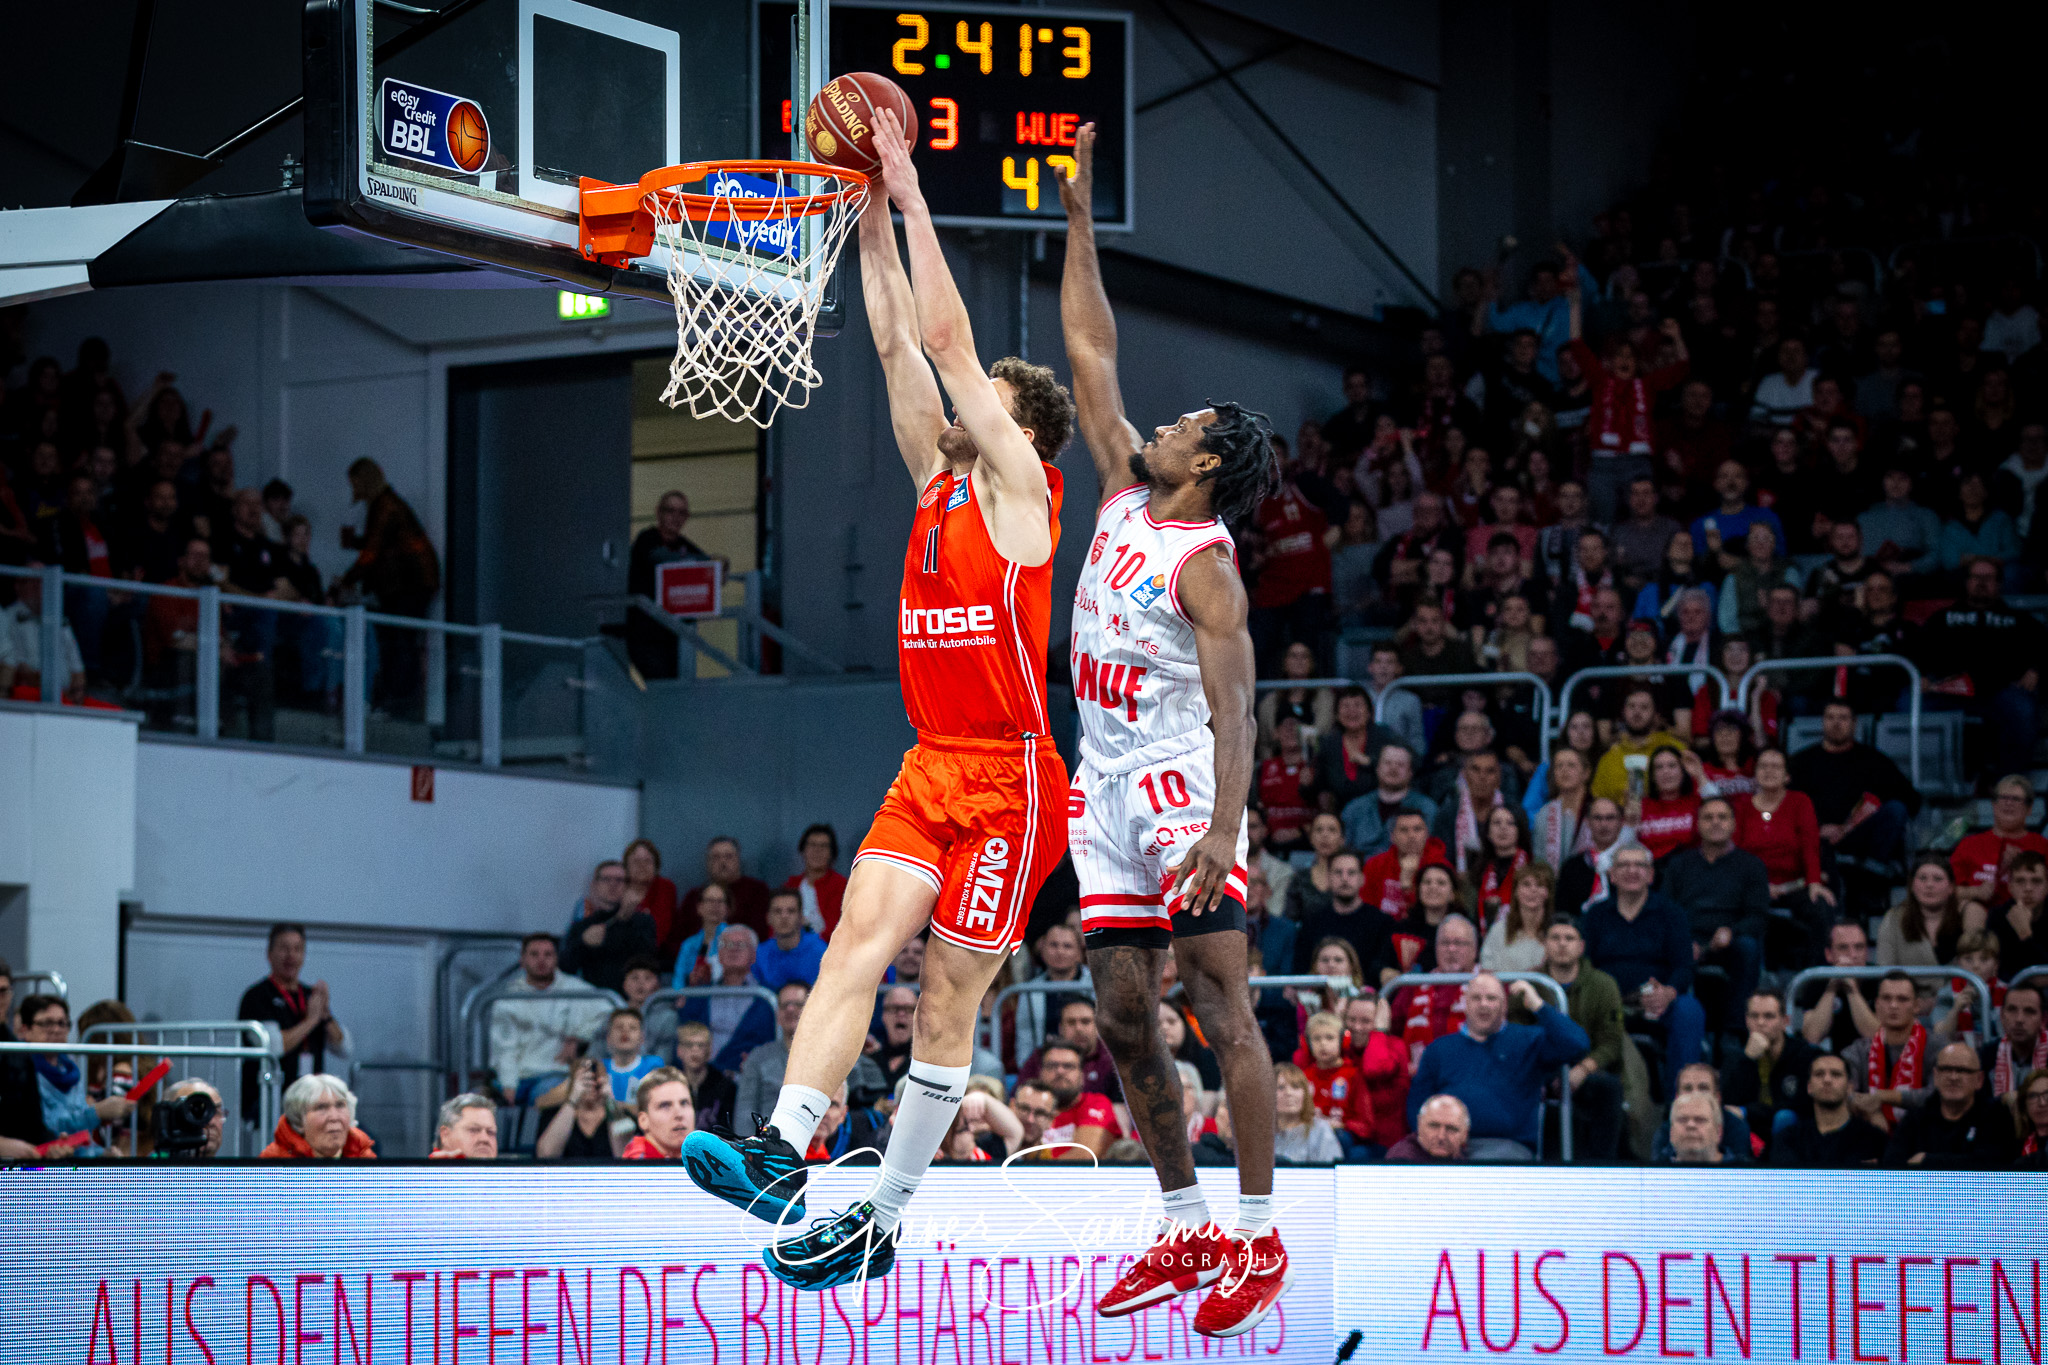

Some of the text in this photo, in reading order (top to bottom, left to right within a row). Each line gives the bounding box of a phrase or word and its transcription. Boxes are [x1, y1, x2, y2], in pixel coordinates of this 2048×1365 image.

[404, 105, 437, 126] Credit
[930, 97, 959, 150] 3
[1016, 111, 1080, 147] WUE
[390, 119, 436, 157] BBL
[366, 177, 418, 205] SPALDING
[1103, 543, 1146, 591] 10
[901, 598, 995, 635] brose
[939, 635, 997, 649] Automobile
[1138, 770, 1191, 815] 10
[955, 888, 970, 926] KOLLEGEN
[87, 1276, 216, 1365] AUS
[246, 1273, 373, 1365] DEN
[390, 1268, 593, 1365] TIEFEN
[619, 1263, 718, 1365] DES
[1421, 1249, 2042, 1365] AUS DEN TIEFEN
